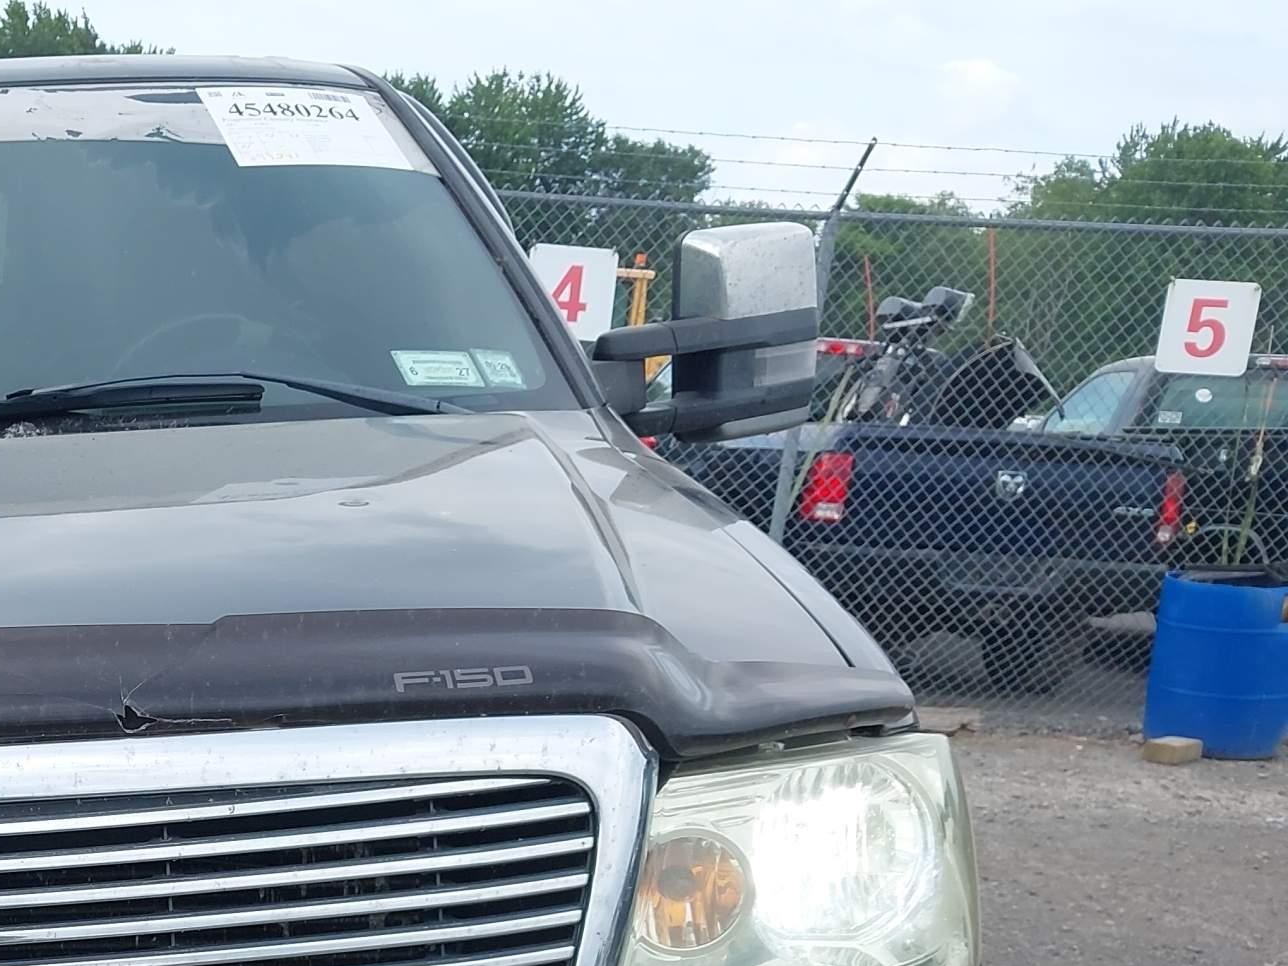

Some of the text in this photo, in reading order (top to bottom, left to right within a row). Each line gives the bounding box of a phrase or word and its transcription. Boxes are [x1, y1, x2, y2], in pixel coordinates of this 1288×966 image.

[228, 102, 360, 121] 45480264
[552, 265, 587, 322] 4
[1184, 298, 1229, 358] 5
[392, 665, 534, 693] F-150
